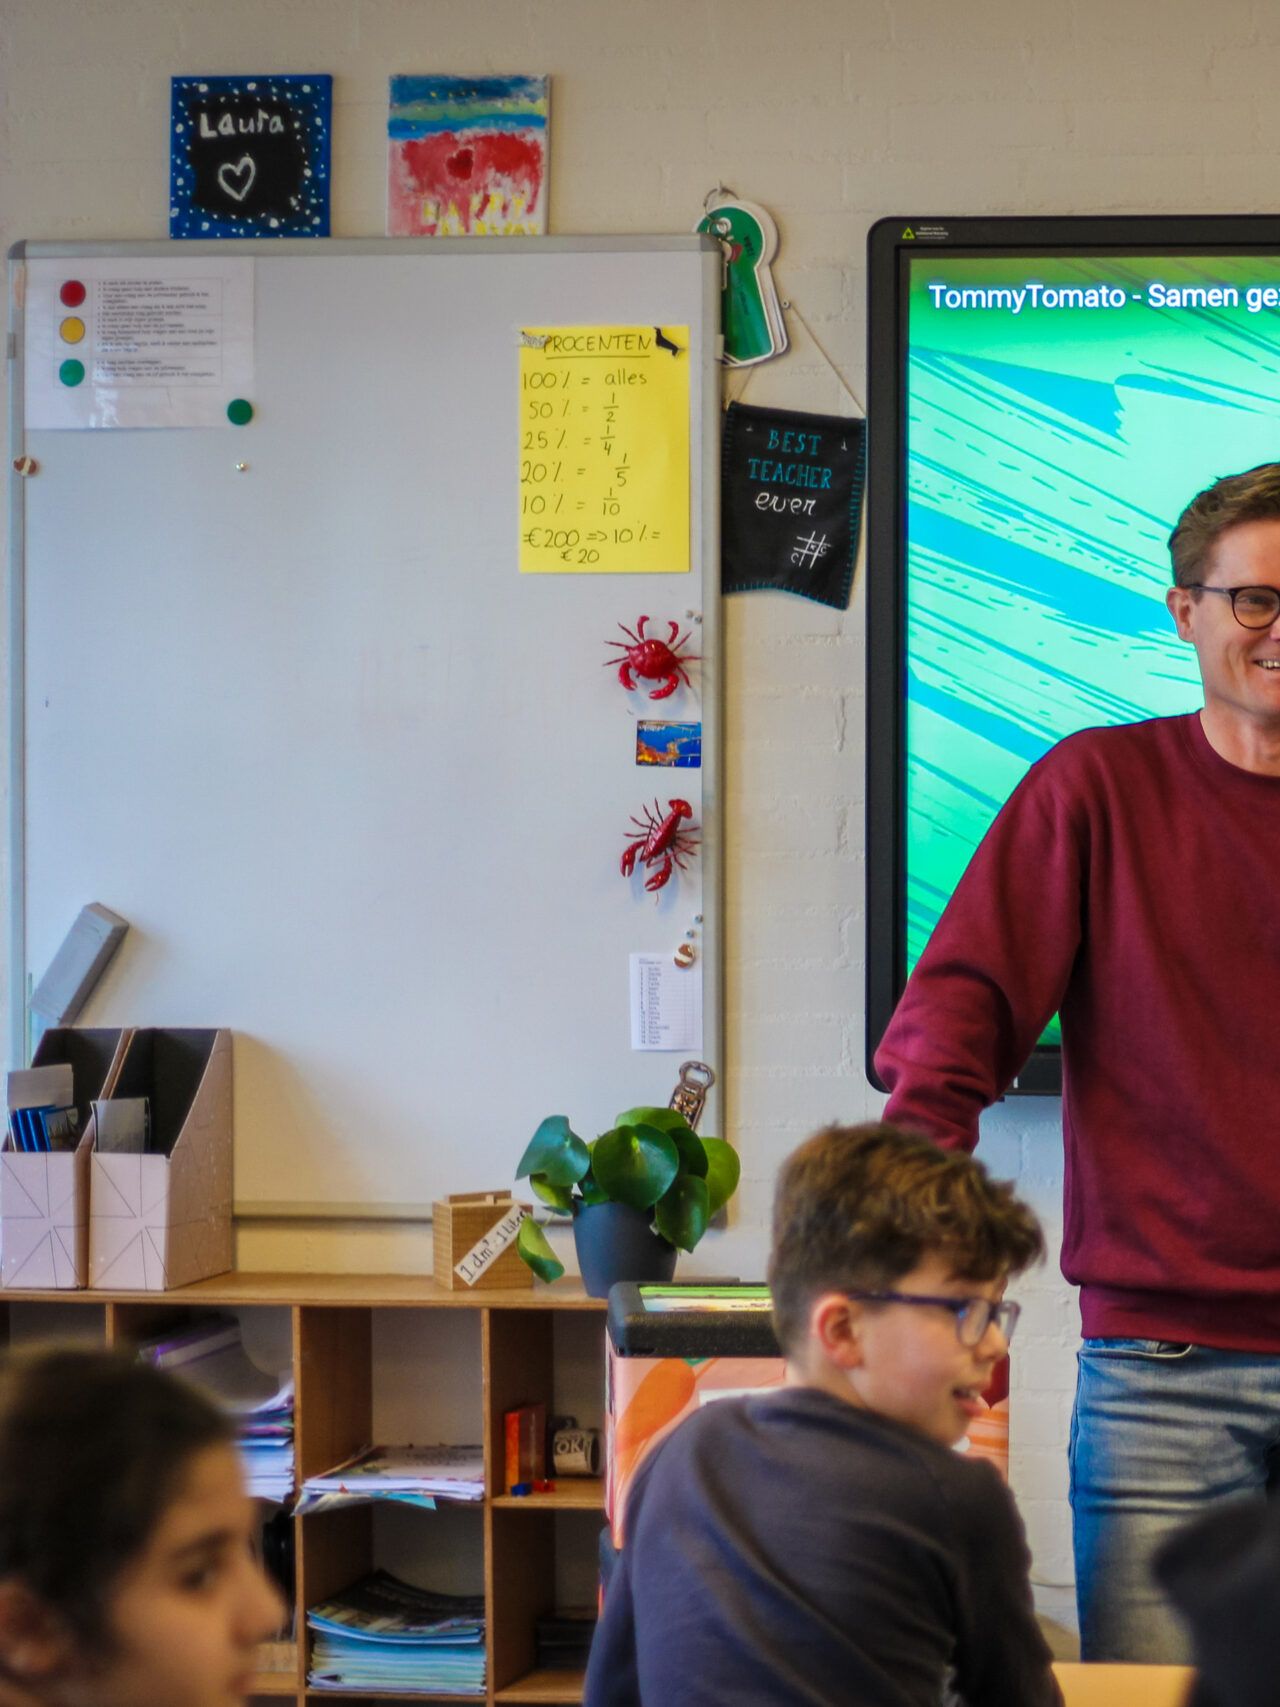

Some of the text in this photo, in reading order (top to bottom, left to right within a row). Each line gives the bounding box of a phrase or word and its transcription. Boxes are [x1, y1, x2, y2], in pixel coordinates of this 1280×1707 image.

[200, 109, 284, 138] Laura
[929, 284, 1126, 314] TommyTomato
[1148, 284, 1238, 308] Samen
[543, 335, 652, 353] PROCENTEN
[604, 368, 648, 385] alles
[767, 428, 822, 455] BEST
[748, 458, 833, 489] TEACHER
[755, 492, 816, 515] ever
